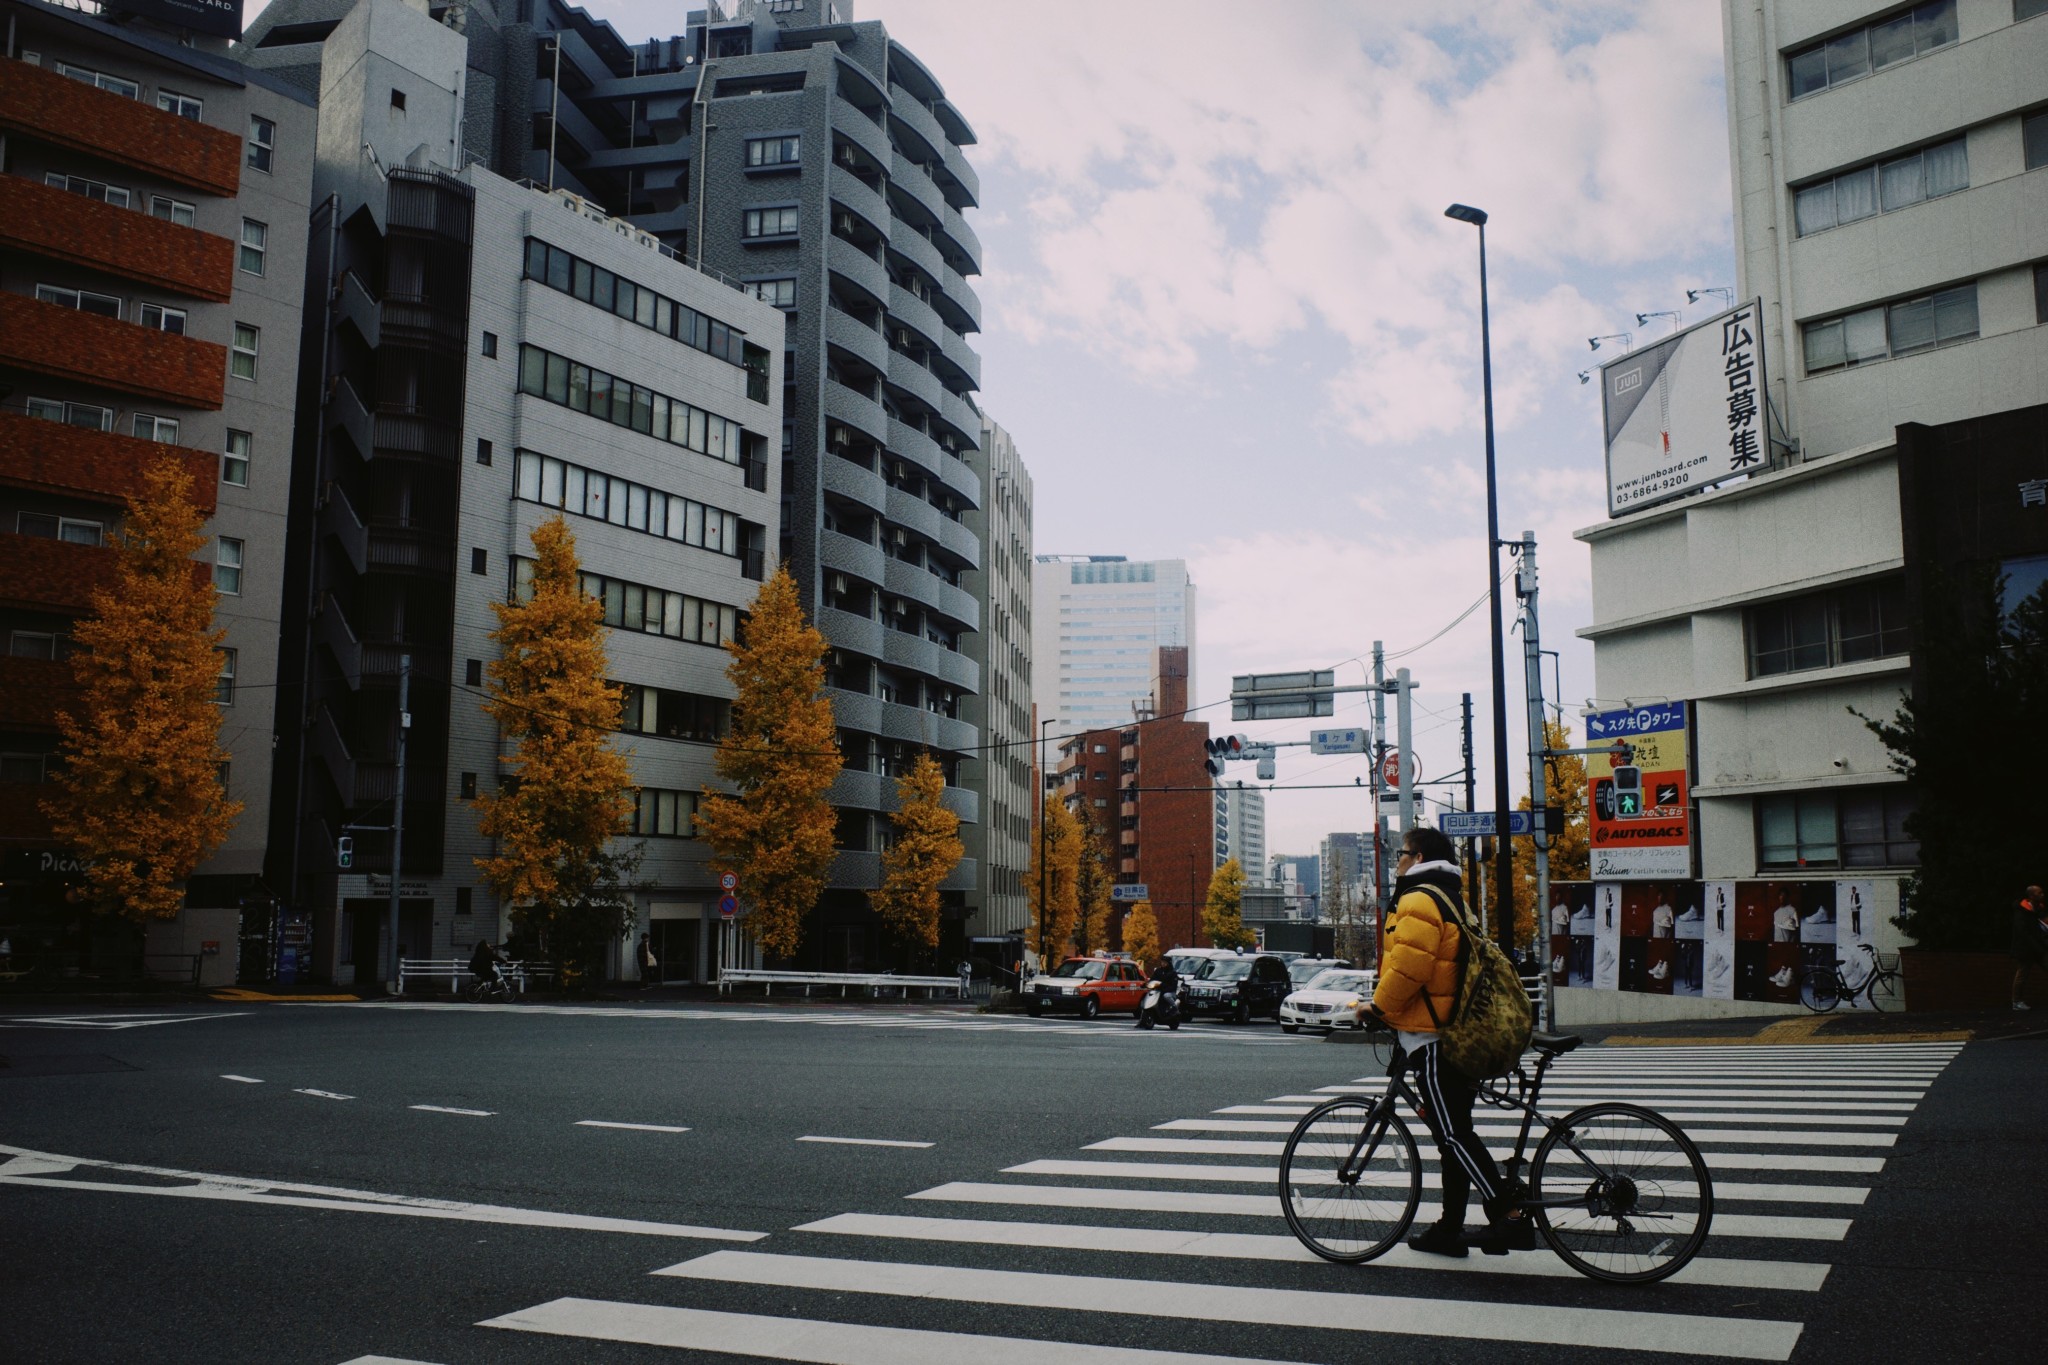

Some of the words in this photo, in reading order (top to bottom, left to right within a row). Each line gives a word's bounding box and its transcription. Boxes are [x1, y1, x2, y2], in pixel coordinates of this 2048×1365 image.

[1722, 311, 1760, 471] 広告募集
[1616, 455, 1708, 491] www.junboard.com
[1617, 473, 1689, 503] 03-6864-9200
[1610, 827, 1684, 839] AUTOBACS
[1595, 858, 1632, 875] Podium
[724, 877, 734, 886] 50
